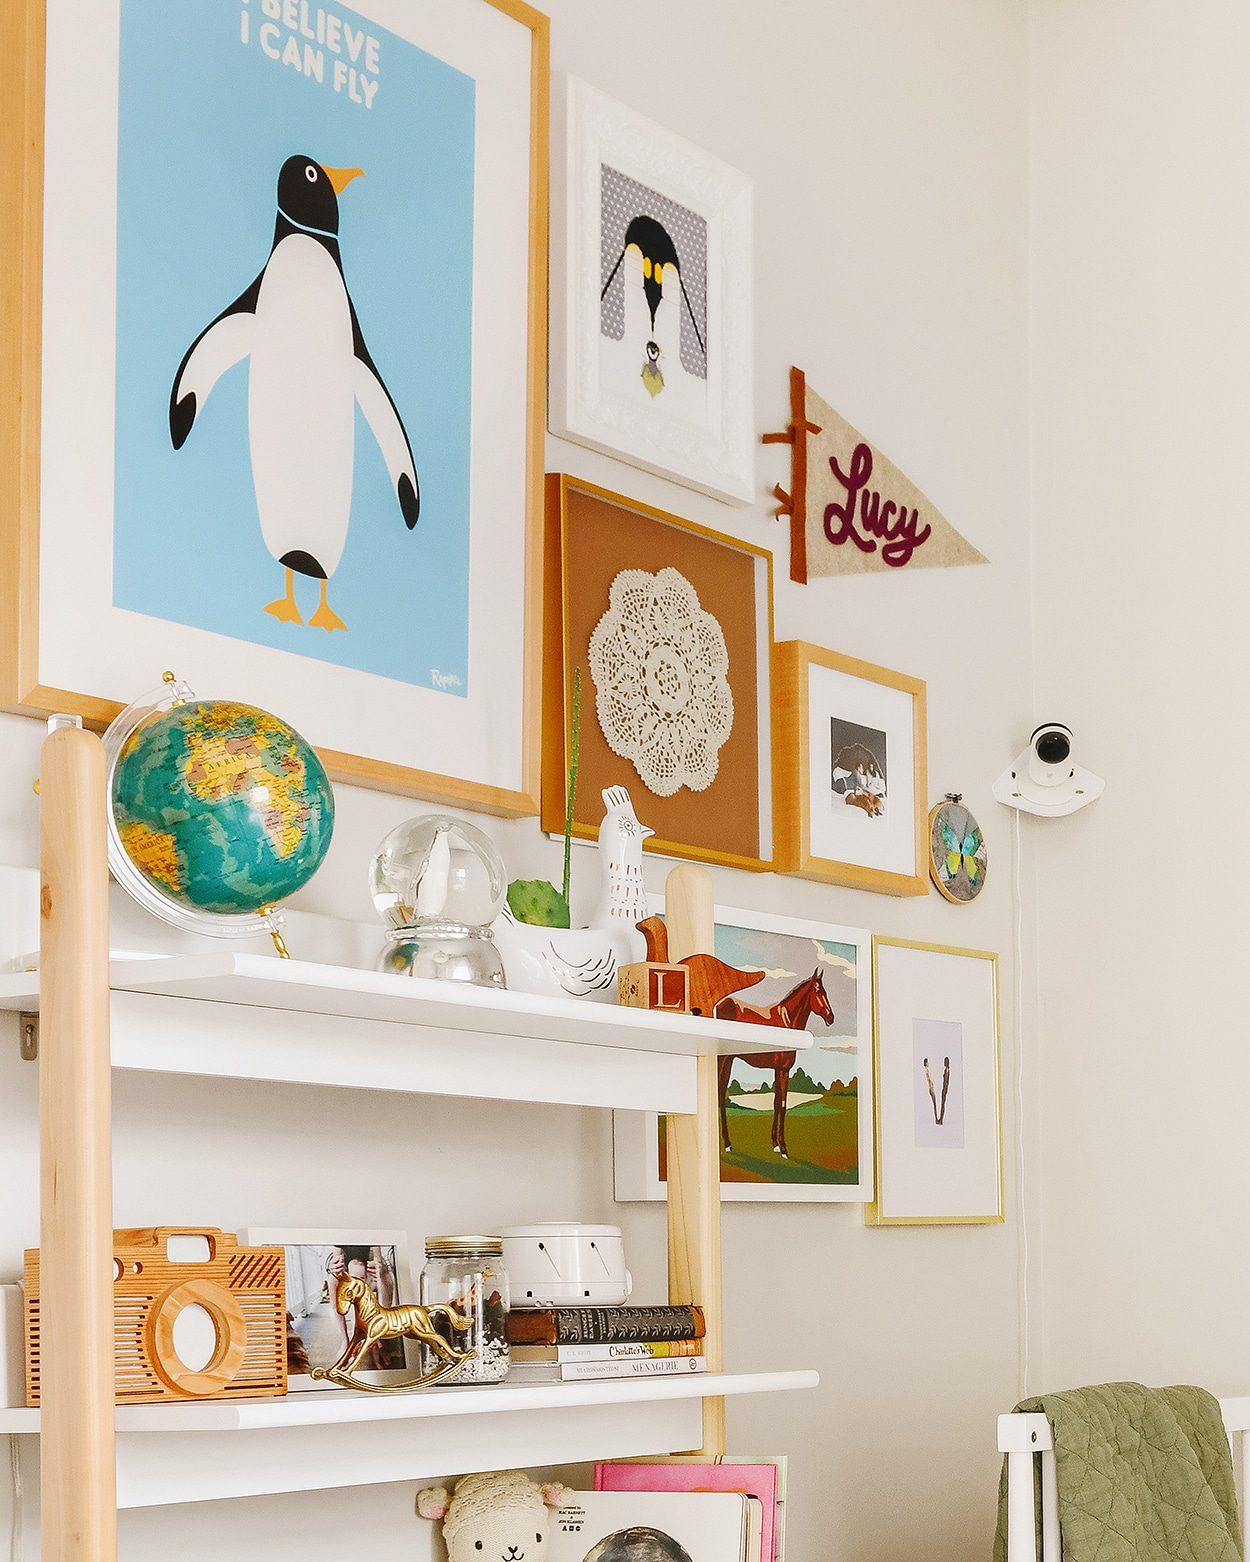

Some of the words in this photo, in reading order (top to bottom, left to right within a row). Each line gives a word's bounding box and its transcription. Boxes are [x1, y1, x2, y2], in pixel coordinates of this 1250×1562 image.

[240, 10, 249, 45] I
[260, 22, 324, 83] CAN
[333, 60, 379, 109] FLY
[262, 0, 380, 74] BELIEVE
[823, 443, 932, 567] Lucy
[208, 752, 253, 771] AFRICA
[653, 971, 682, 1008] L
[632, 1360, 679, 1373] MENAGERIE
